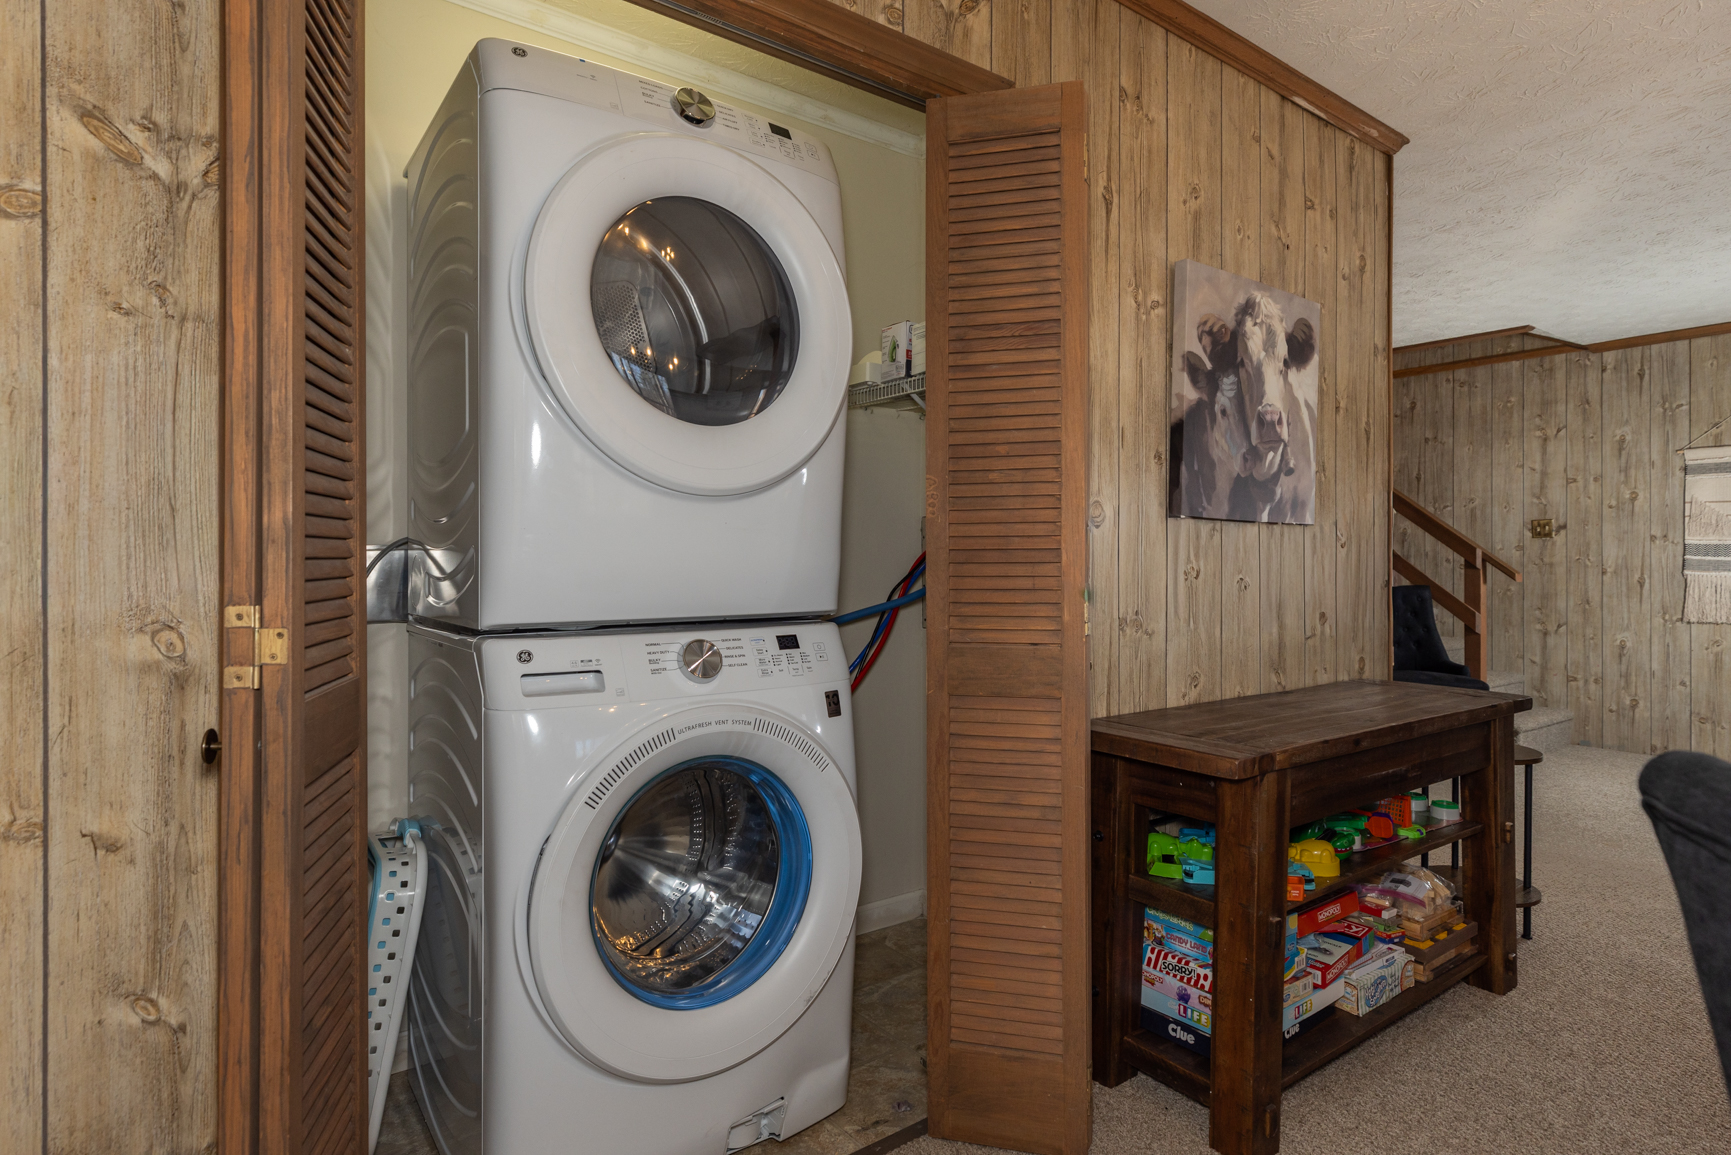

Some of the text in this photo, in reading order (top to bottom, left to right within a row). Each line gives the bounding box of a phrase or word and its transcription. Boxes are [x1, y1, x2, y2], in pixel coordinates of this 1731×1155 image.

[678, 721, 712, 734] ULTRAFRESH
[1318, 904, 1340, 920] MONOPOLY
[1166, 932, 1188, 946] CANDY
[1190, 941, 1207, 953] LAND
[1142, 971, 1163, 984] ONOPOLY
[1162, 962, 1196, 978] SORRY!
[1180, 1005, 1208, 1026] LIFE
[1296, 1000, 1312, 1018] LIFE
[1168, 1023, 1195, 1044] Clue
[1285, 1024, 1299, 1039] Clue
